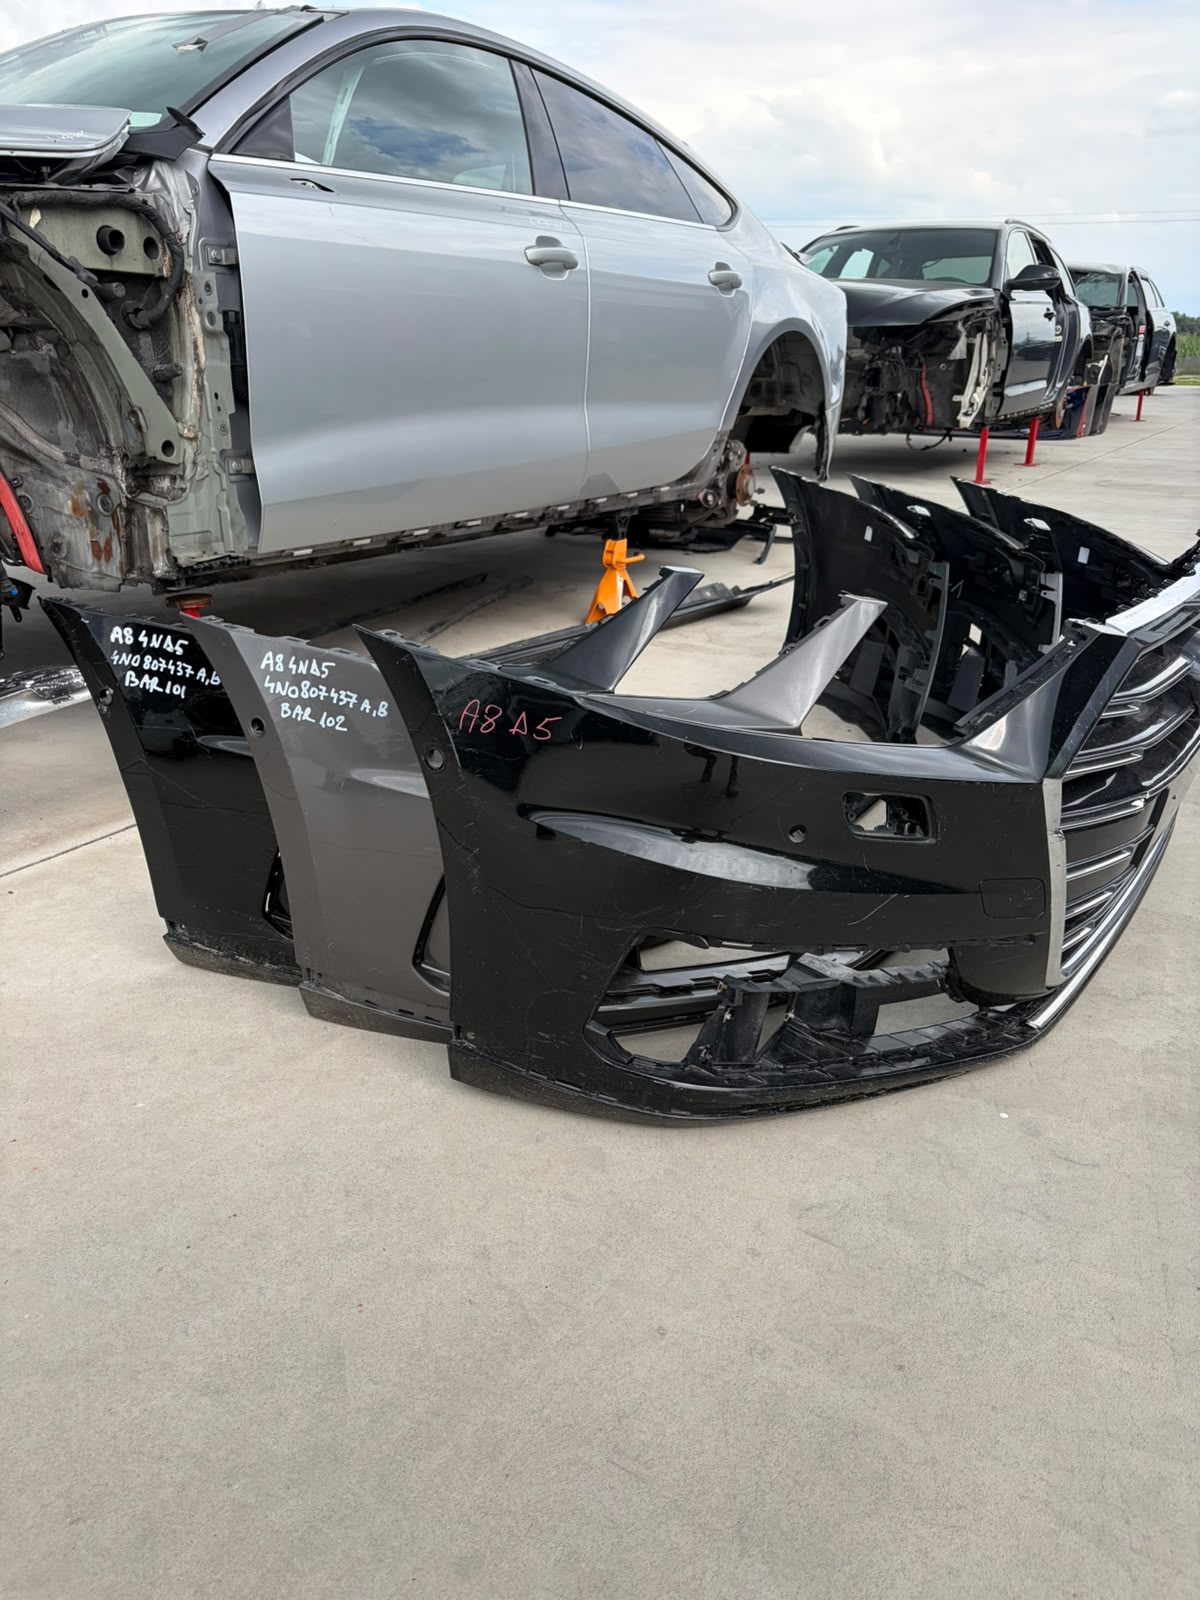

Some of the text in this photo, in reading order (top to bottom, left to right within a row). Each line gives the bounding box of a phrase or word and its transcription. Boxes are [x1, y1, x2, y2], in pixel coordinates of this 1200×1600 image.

[110, 626, 134, 645] A8
[261, 651, 285, 672] A8
[124, 670, 187, 699] BAR 101
[280, 702, 348, 732] BAR 102
[458, 698, 503, 734] A8
